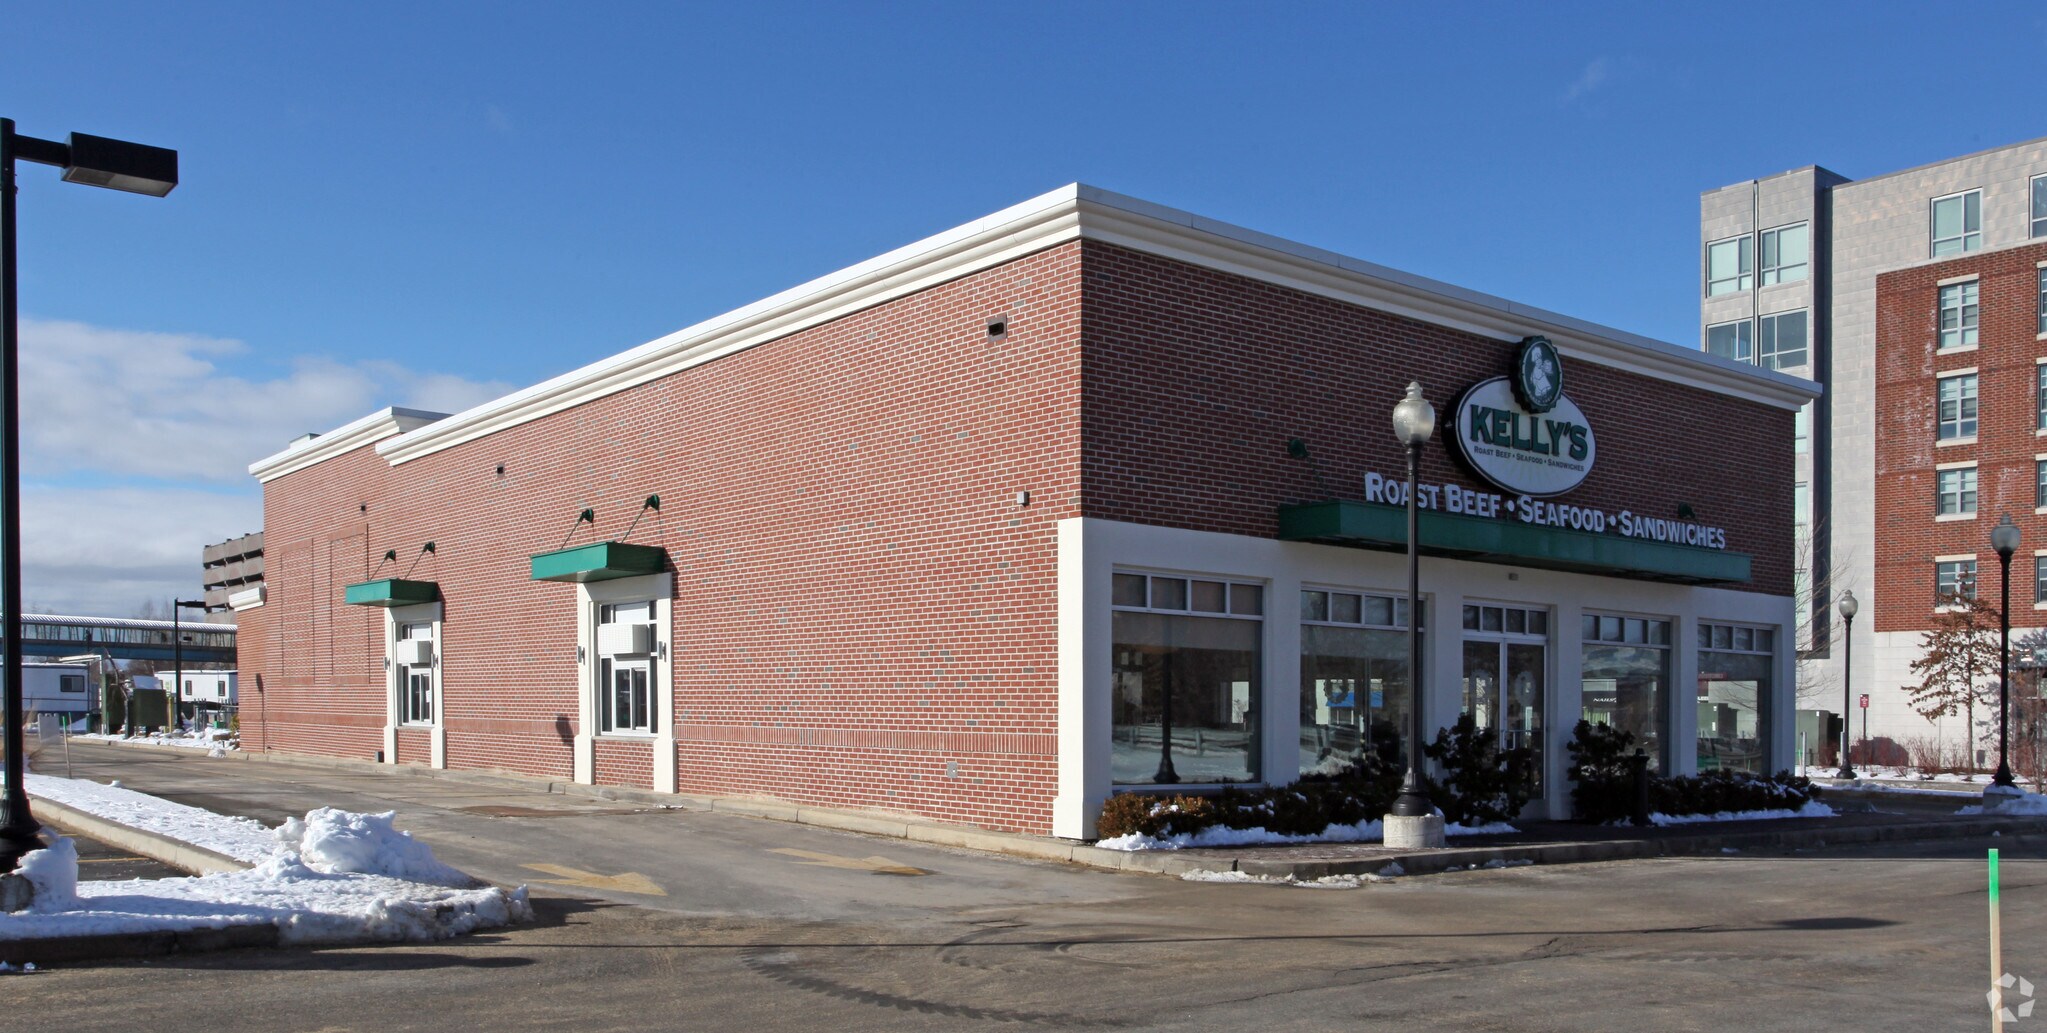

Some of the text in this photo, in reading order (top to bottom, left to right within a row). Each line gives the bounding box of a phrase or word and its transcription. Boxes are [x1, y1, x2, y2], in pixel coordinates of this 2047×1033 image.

[1470, 404, 1588, 461] KELLY'S
[1474, 445, 1585, 472] ROAST BEEF SEAFOOD SANDWICHES
[1444, 483, 1502, 518] BEEF
[1517, 494, 1605, 533] SEAFOOD
[1618, 509, 1726, 550] SANDWICHES
